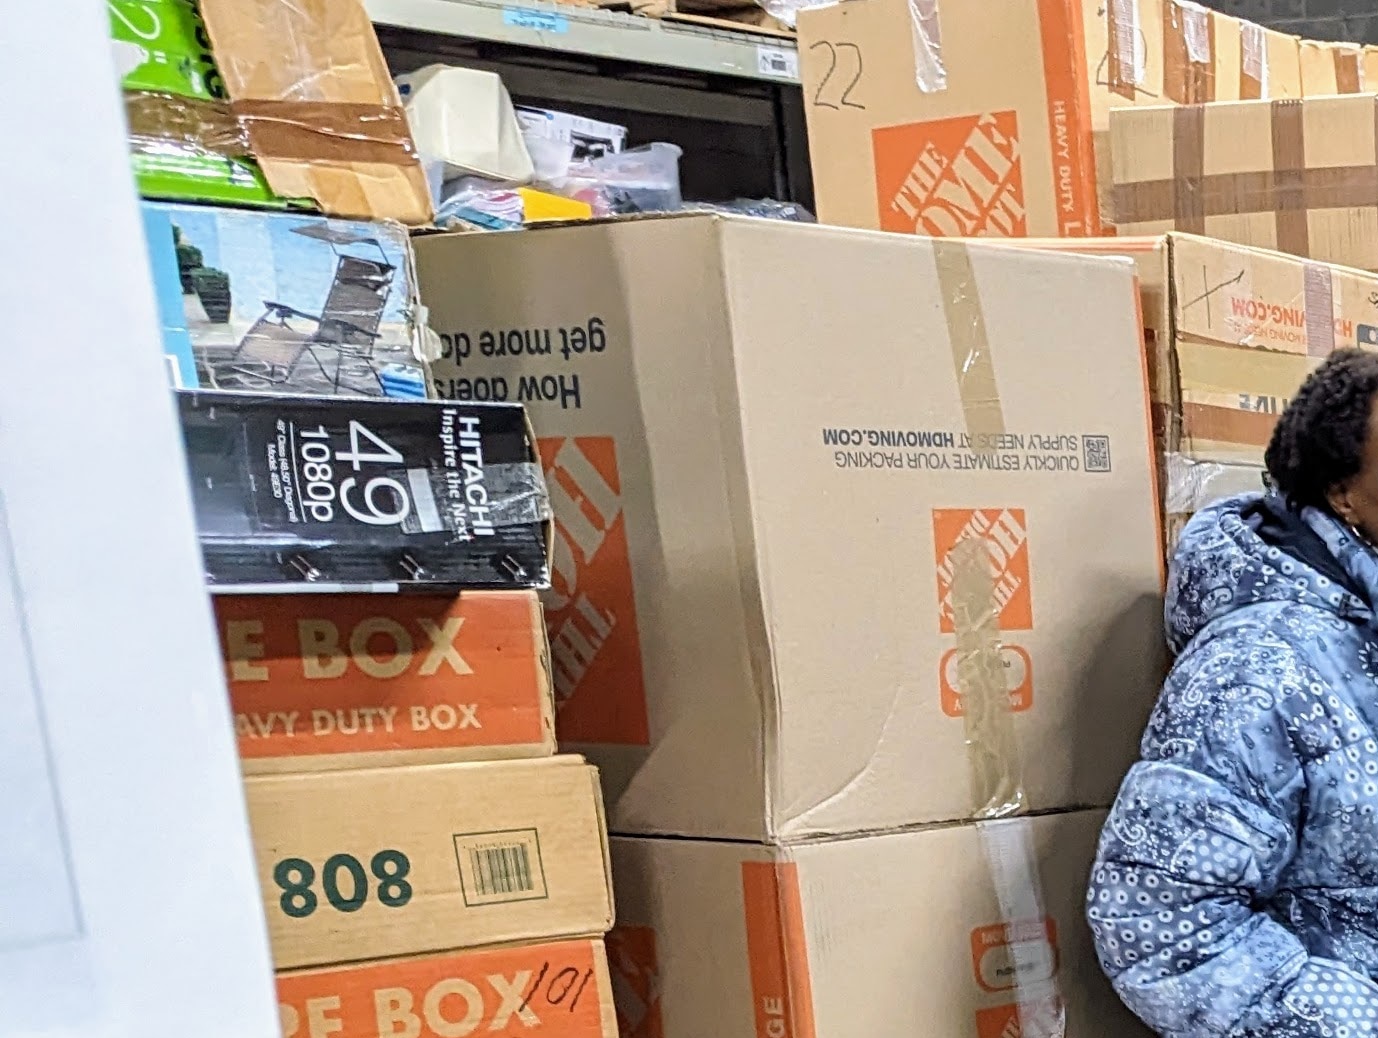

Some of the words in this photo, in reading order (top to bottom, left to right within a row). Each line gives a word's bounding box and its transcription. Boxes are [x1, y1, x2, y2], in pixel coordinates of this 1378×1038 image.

[809, 40, 866, 110] 22
[1053, 100, 1072, 159] HEAVY
[891, 141, 948, 220] THE
[1058, 165, 1074, 213] DUTY
[479, 325, 551, 356] more
[559, 316, 606, 361] get
[517, 374, 581, 409] How
[438, 408, 458, 468] Inspire
[823, 428, 954, 448] HDMOVING.COM
[957, 433, 973, 449] AT
[978, 433, 1027, 449] NEEDS
[1027, 434, 1078, 450] SUPPLY
[300, 425, 336, 522] 1080p
[335, 419, 410, 526] 49
[458, 416, 495, 536] HITACHI
[835, 451, 904, 468] PACKING
[907, 452, 950, 469] YOUR
[953, 453, 1020, 470] ESTIMATE
[1023, 455, 1079, 471] QUICKLY
[445, 470, 459, 499] the
[452, 502, 472, 543] Next
[300, 616, 474, 679] BOX
[311, 706, 398, 736] DUTY
[411, 703, 482, 732] BOX
[273, 849, 413, 918] 808
